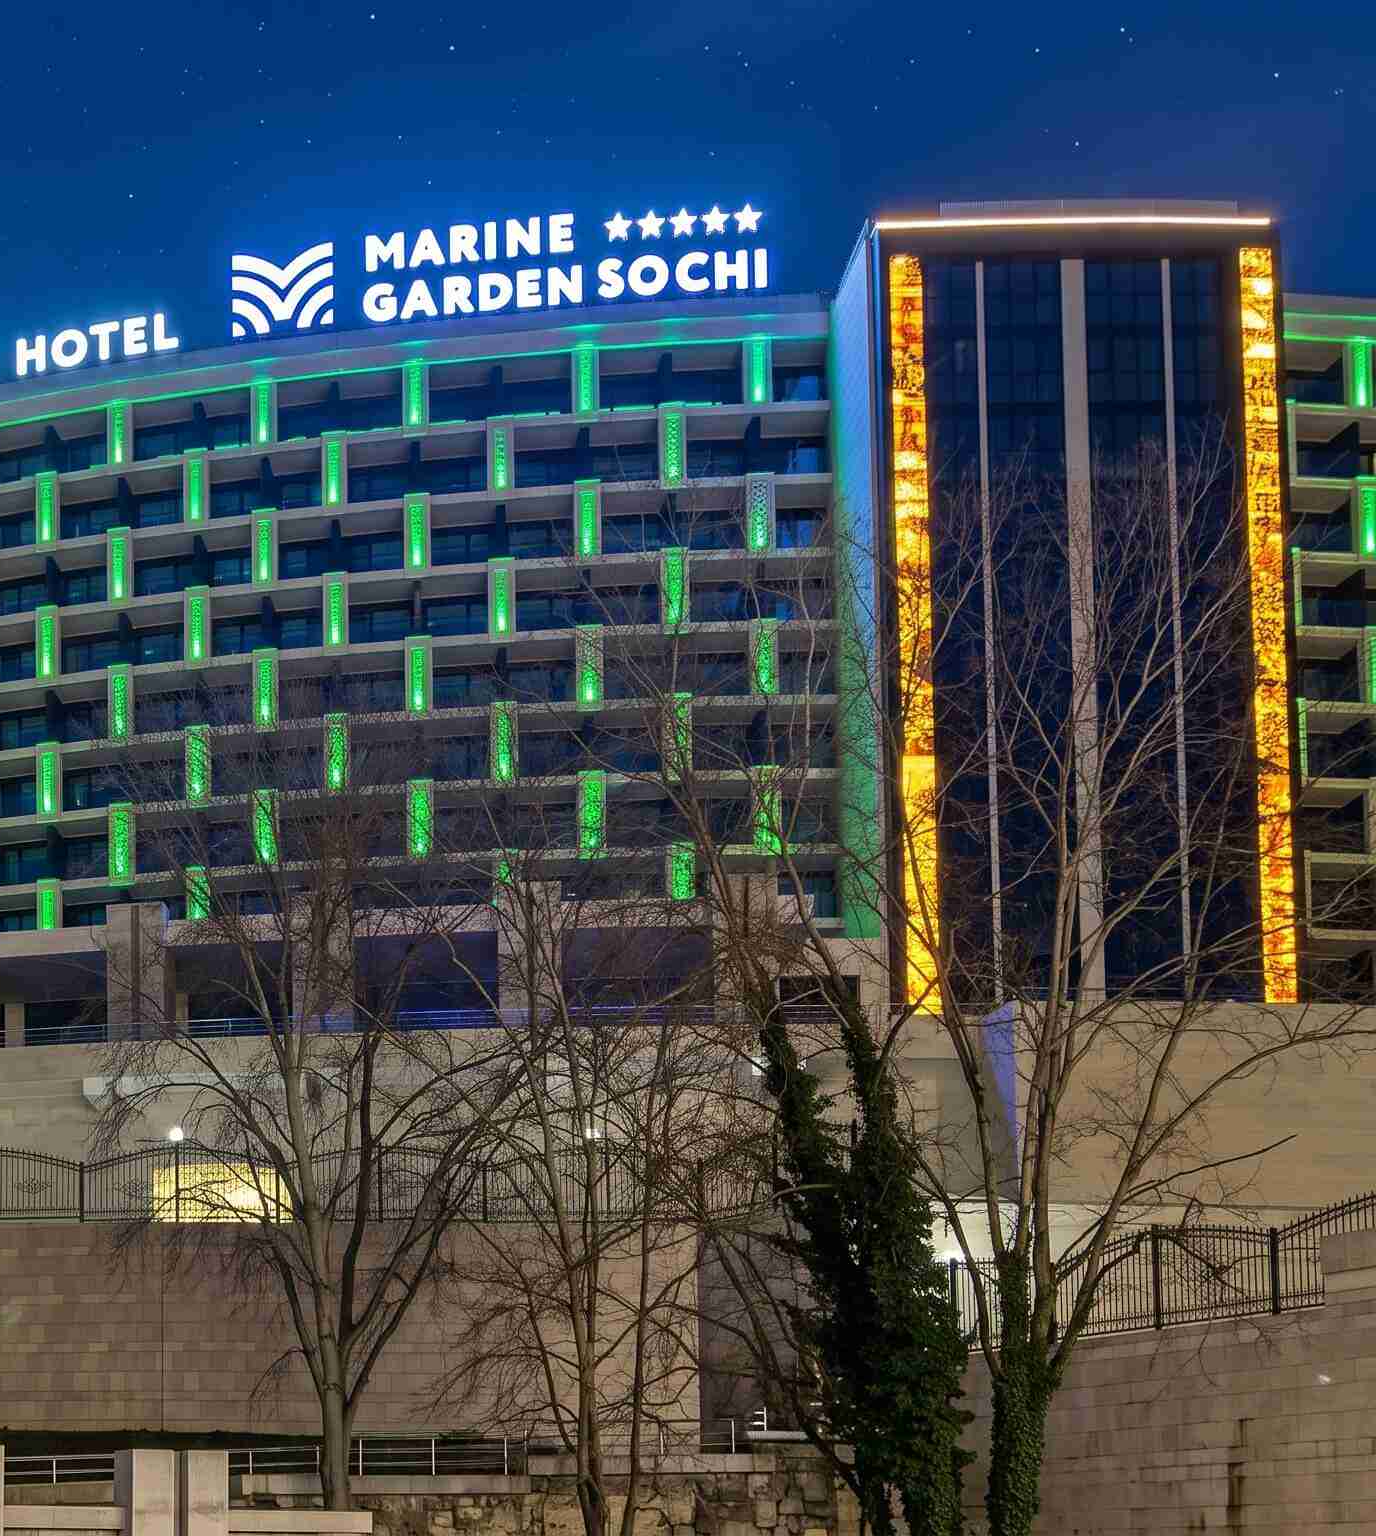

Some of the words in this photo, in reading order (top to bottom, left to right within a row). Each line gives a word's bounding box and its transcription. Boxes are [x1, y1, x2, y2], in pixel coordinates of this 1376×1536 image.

[365, 213, 574, 272] MARINE
[362, 264, 584, 322] GARDEN
[598, 248, 768, 299] SOCHI
[16, 313, 179, 376] HOTEL
